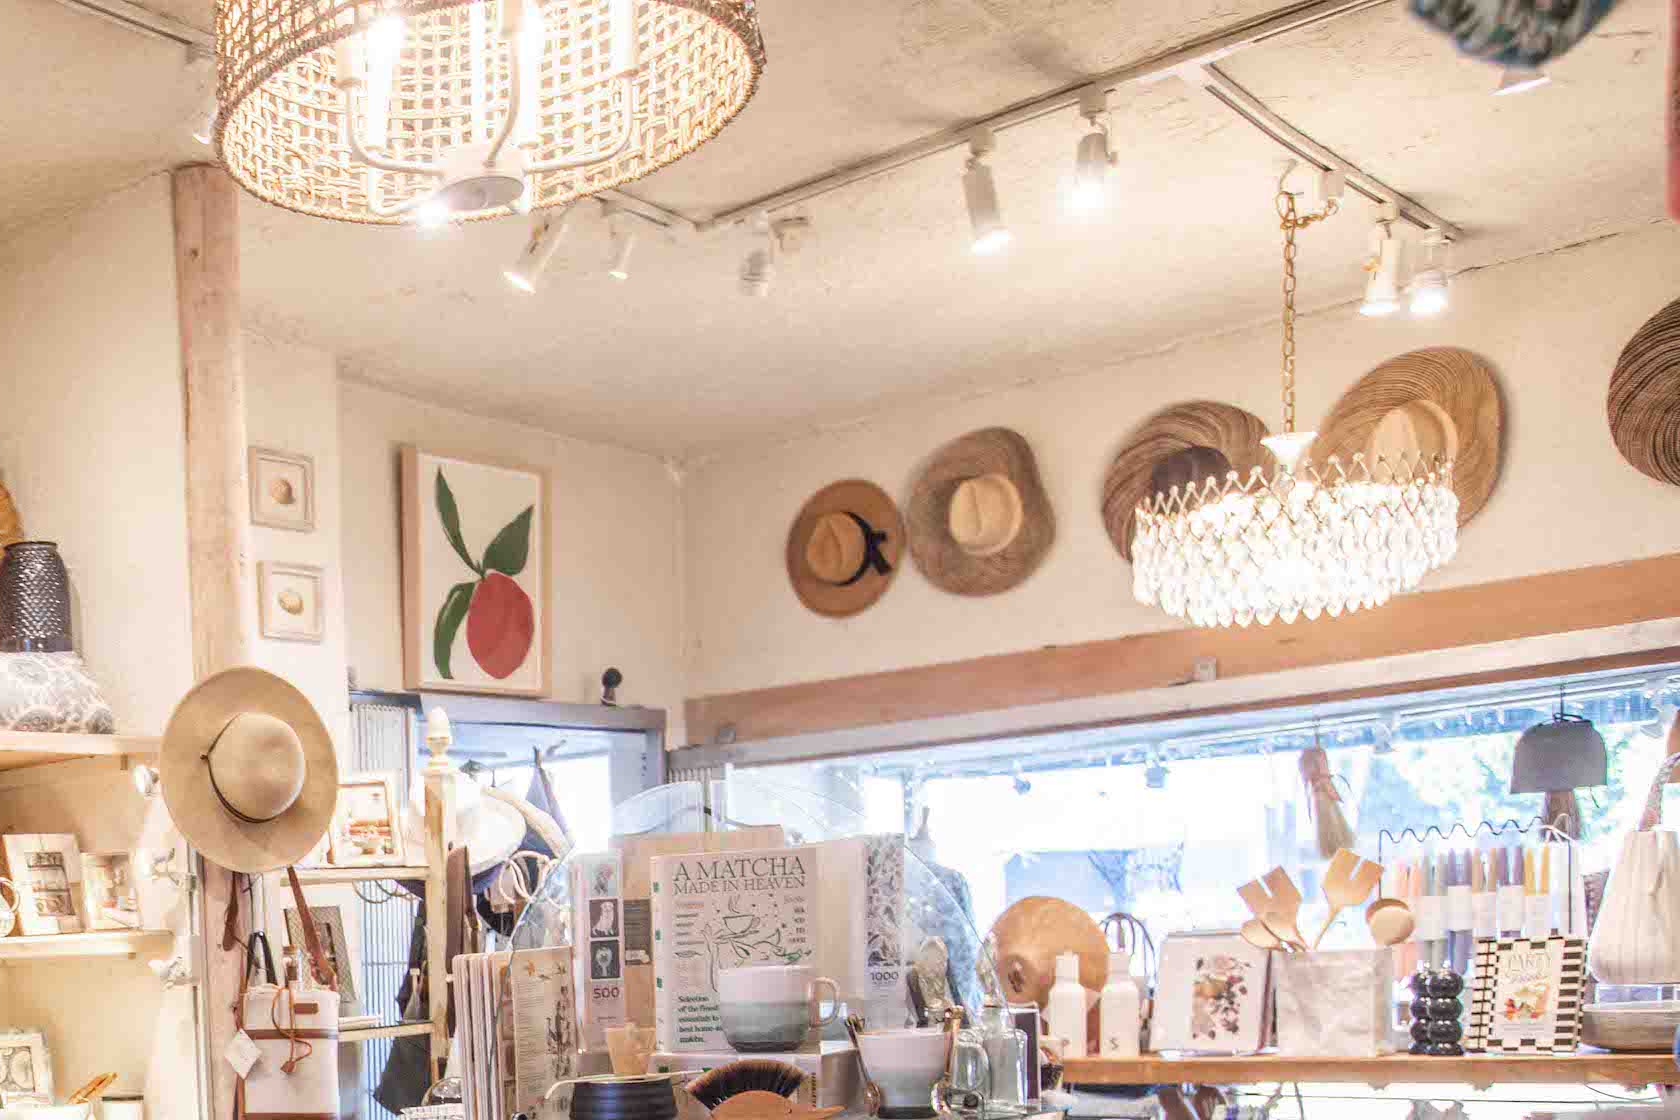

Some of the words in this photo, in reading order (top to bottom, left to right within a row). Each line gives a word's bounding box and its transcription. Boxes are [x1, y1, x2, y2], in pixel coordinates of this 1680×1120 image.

[674, 862, 691, 881] A
[697, 856, 806, 880] MATCHA
[673, 879, 722, 895] MADE
[723, 880, 739, 892] IN
[744, 876, 806, 891] HEAVEN
[871, 970, 899, 982] 1000
[593, 988, 619, 999] 500
